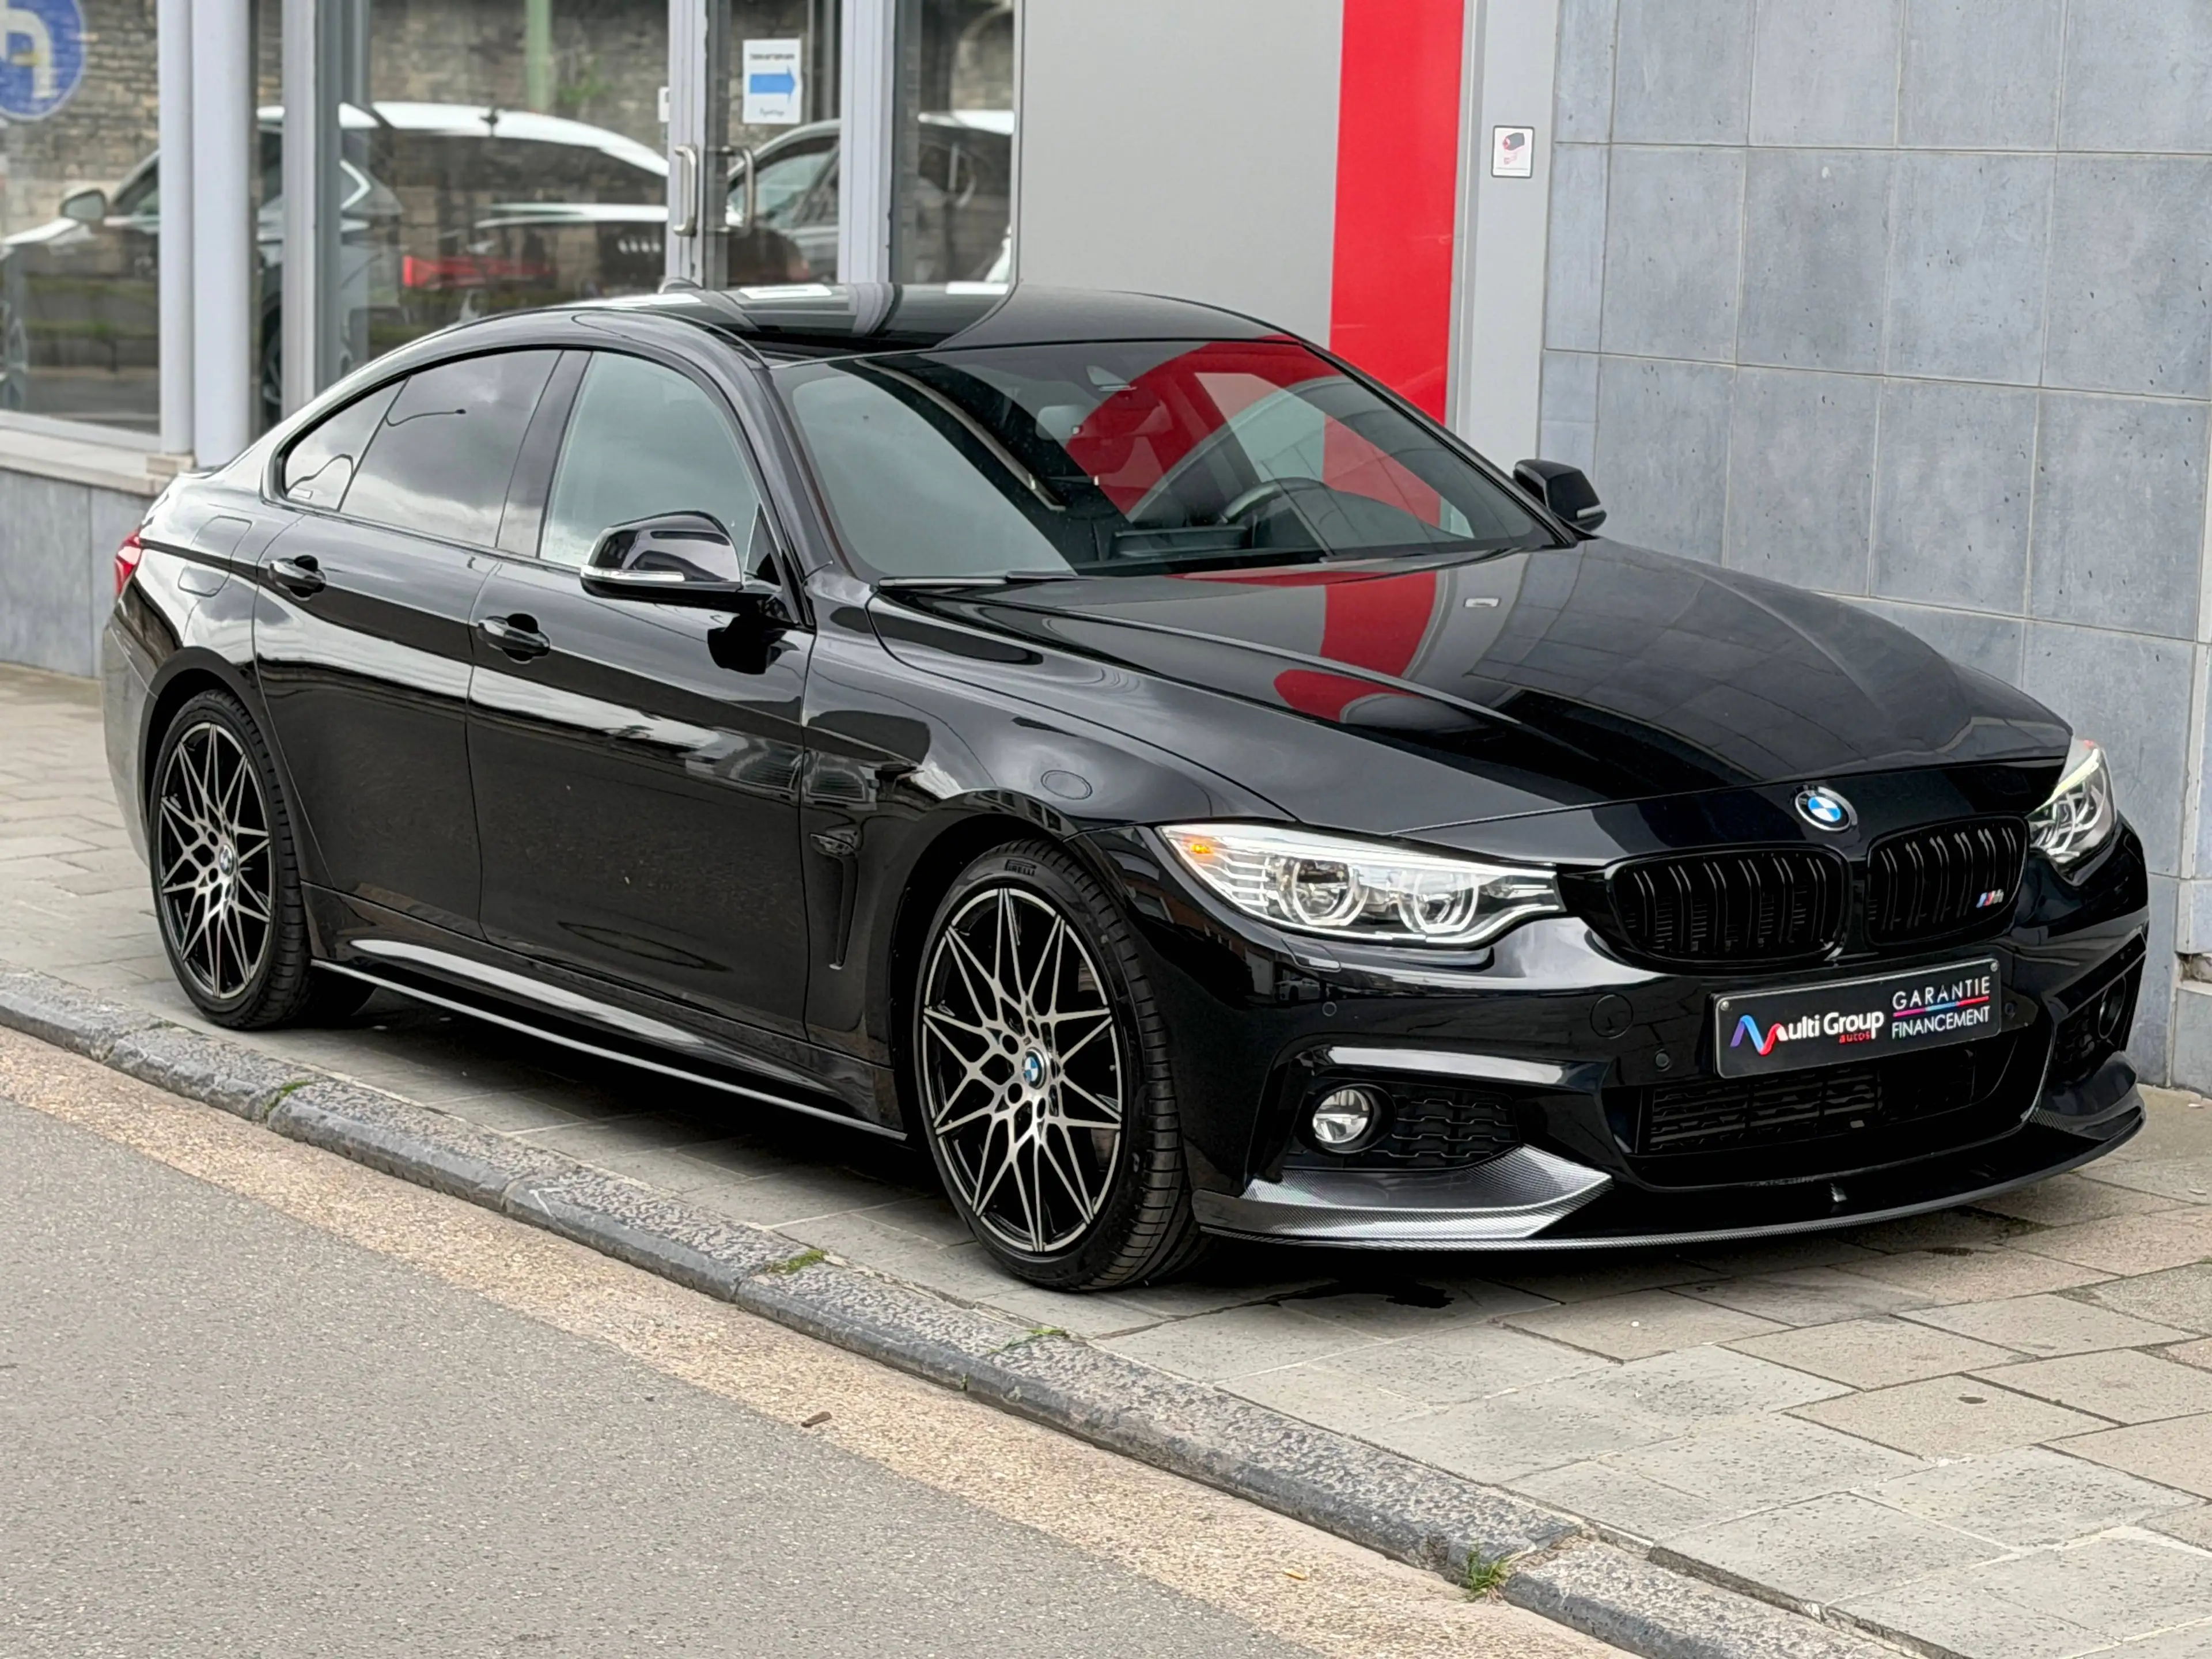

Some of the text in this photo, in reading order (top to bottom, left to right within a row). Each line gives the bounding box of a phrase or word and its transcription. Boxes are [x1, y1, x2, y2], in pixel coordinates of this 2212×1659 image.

[1892, 976, 1990, 1011] GARANTIE
[1823, 1010, 1884, 1040] Group
[1839, 1031, 1871, 1044] autos
[1892, 1006, 1990, 1039] FINANCEMENT
